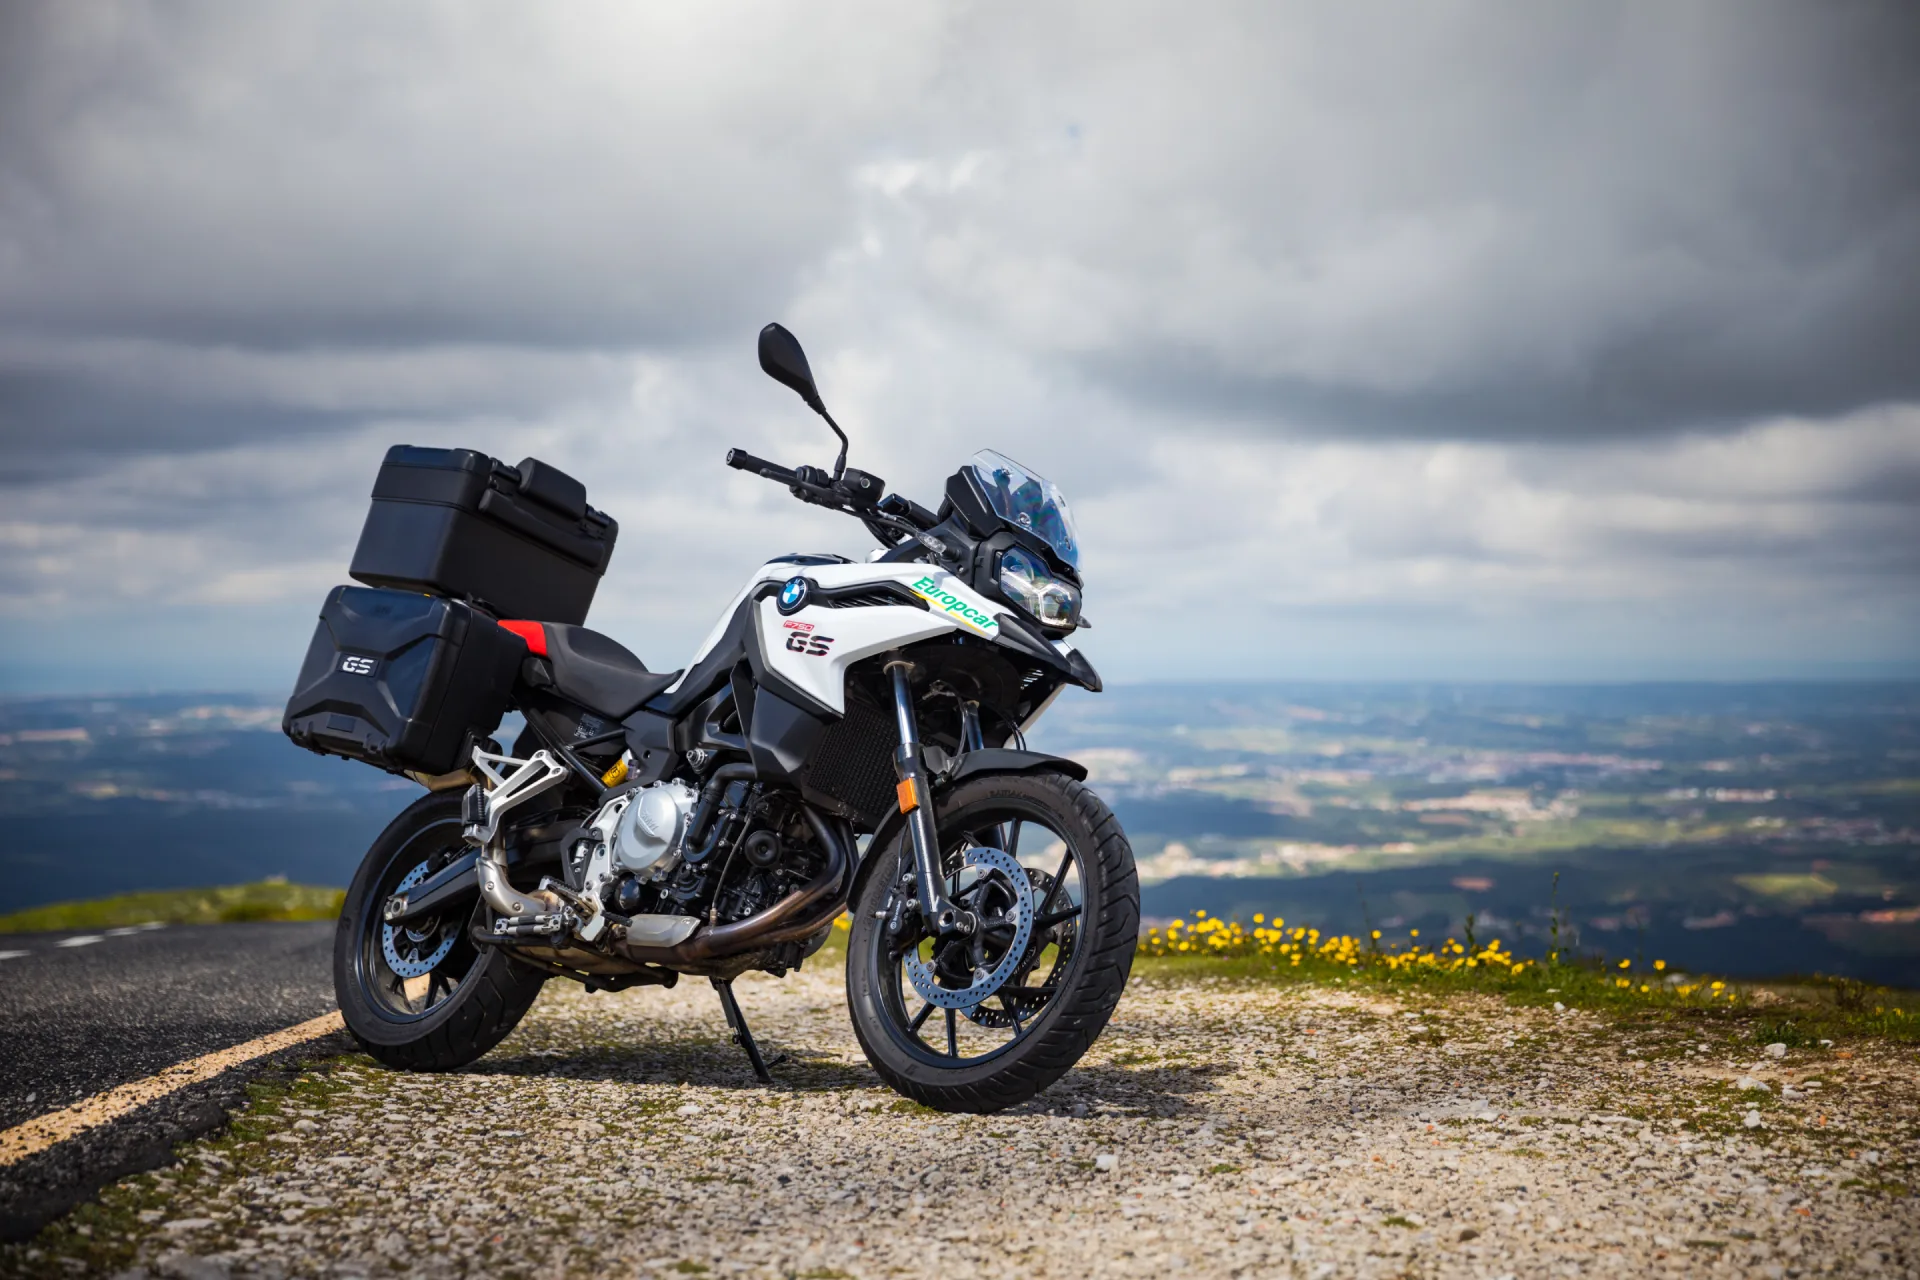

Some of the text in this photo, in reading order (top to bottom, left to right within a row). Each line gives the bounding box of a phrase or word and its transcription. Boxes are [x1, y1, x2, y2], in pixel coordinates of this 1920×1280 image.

[912, 576, 998, 628] Europcar
[786, 631, 834, 657] GS
[342, 656, 374, 674] GS
